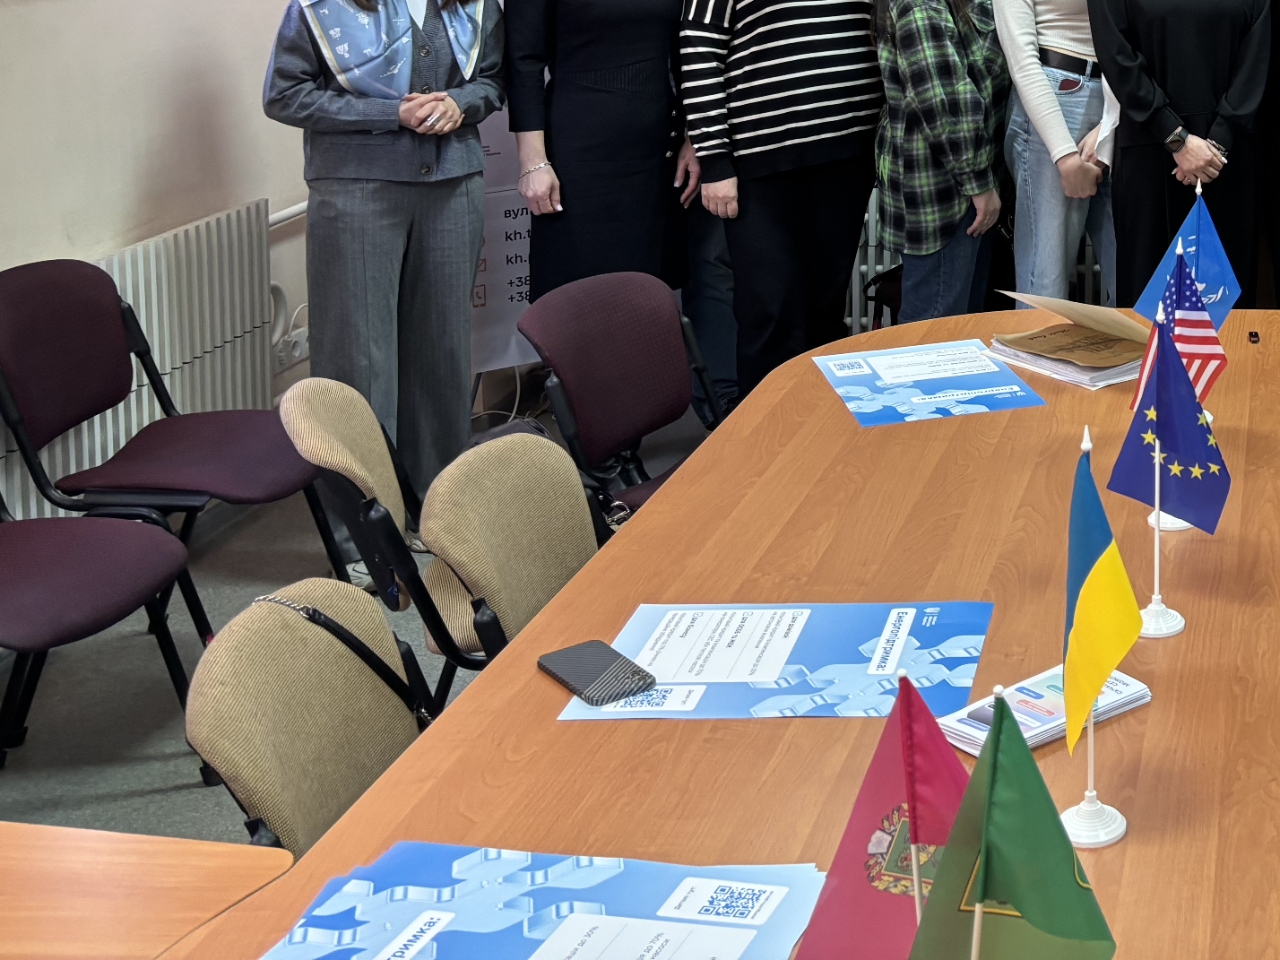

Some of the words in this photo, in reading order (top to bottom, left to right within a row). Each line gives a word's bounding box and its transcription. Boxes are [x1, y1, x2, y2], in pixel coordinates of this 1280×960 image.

[505, 228, 531, 242] kh.t
[507, 275, 531, 288] +38
[508, 290, 531, 303] +38
